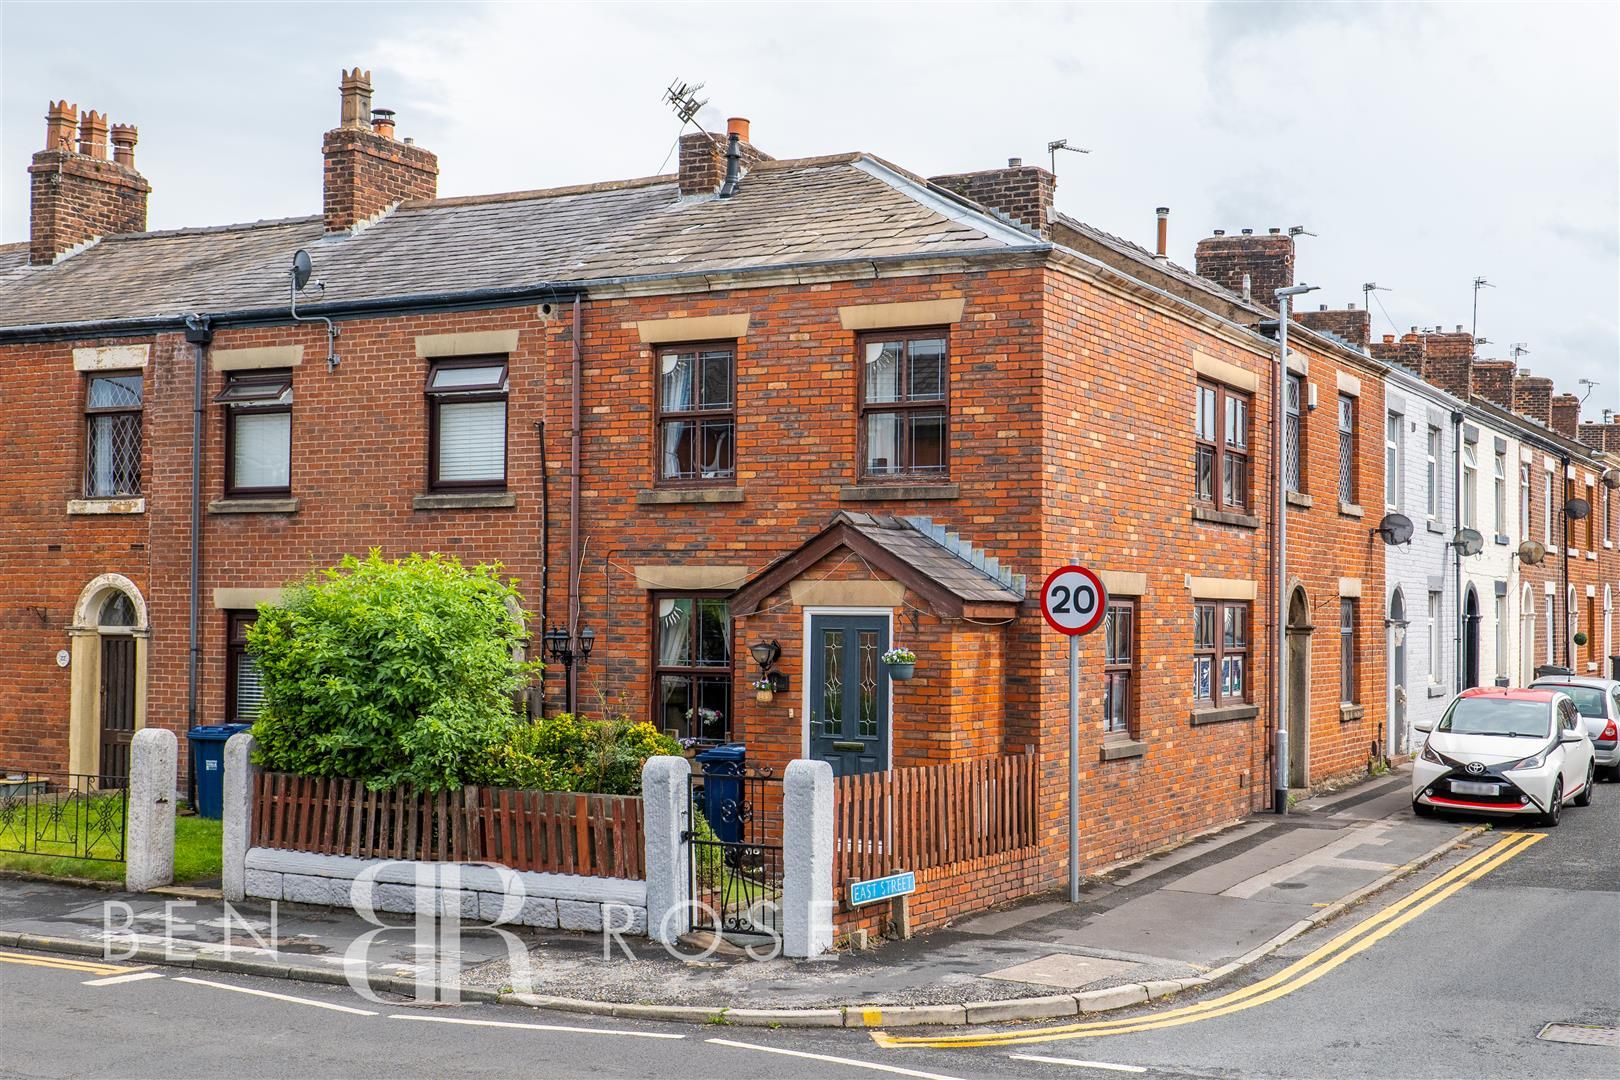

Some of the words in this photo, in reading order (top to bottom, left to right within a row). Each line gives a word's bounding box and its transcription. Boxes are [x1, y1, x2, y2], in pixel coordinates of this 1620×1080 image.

[1051, 585, 1095, 614] 20
[854, 883, 878, 901] EAST
[881, 875, 913, 896] STREET
